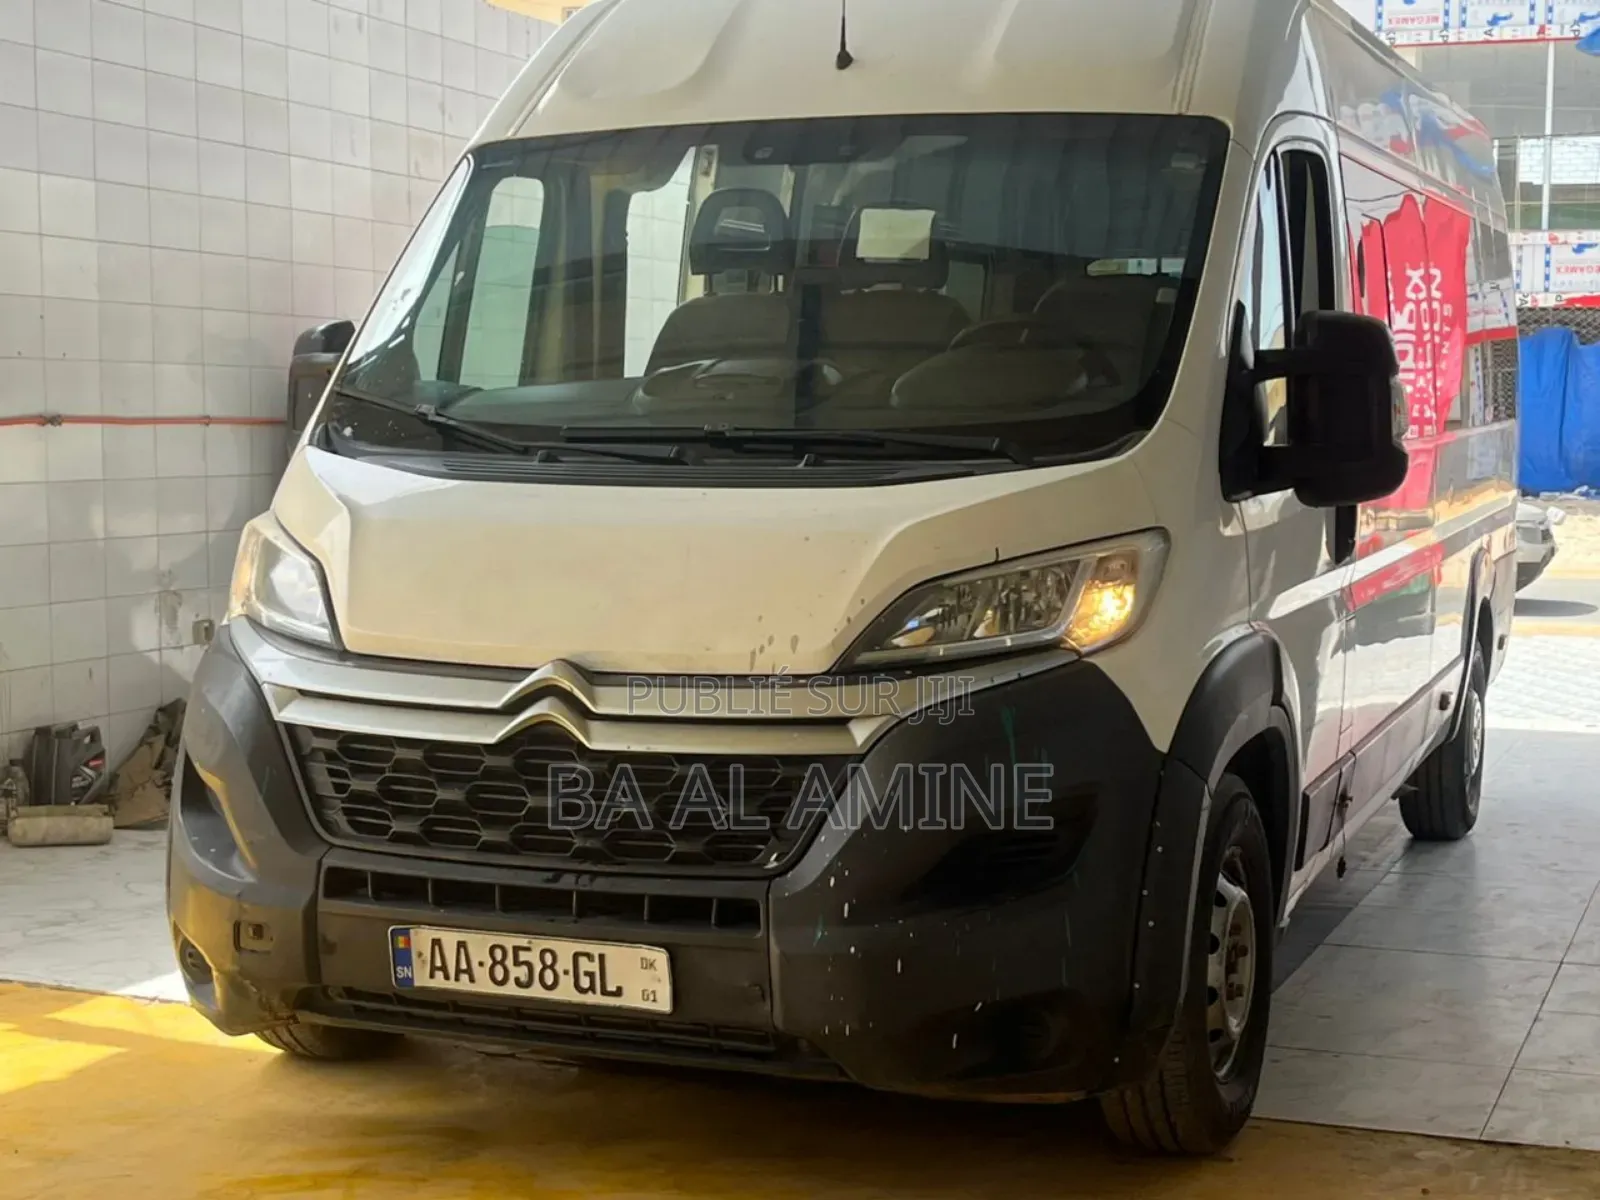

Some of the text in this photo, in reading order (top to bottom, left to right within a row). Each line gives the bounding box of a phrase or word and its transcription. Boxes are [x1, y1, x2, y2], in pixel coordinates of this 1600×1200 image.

[1555, 264, 1600, 275] EGAMEX
[640, 956, 658, 971] DK
[396, 965, 413, 979] SN
